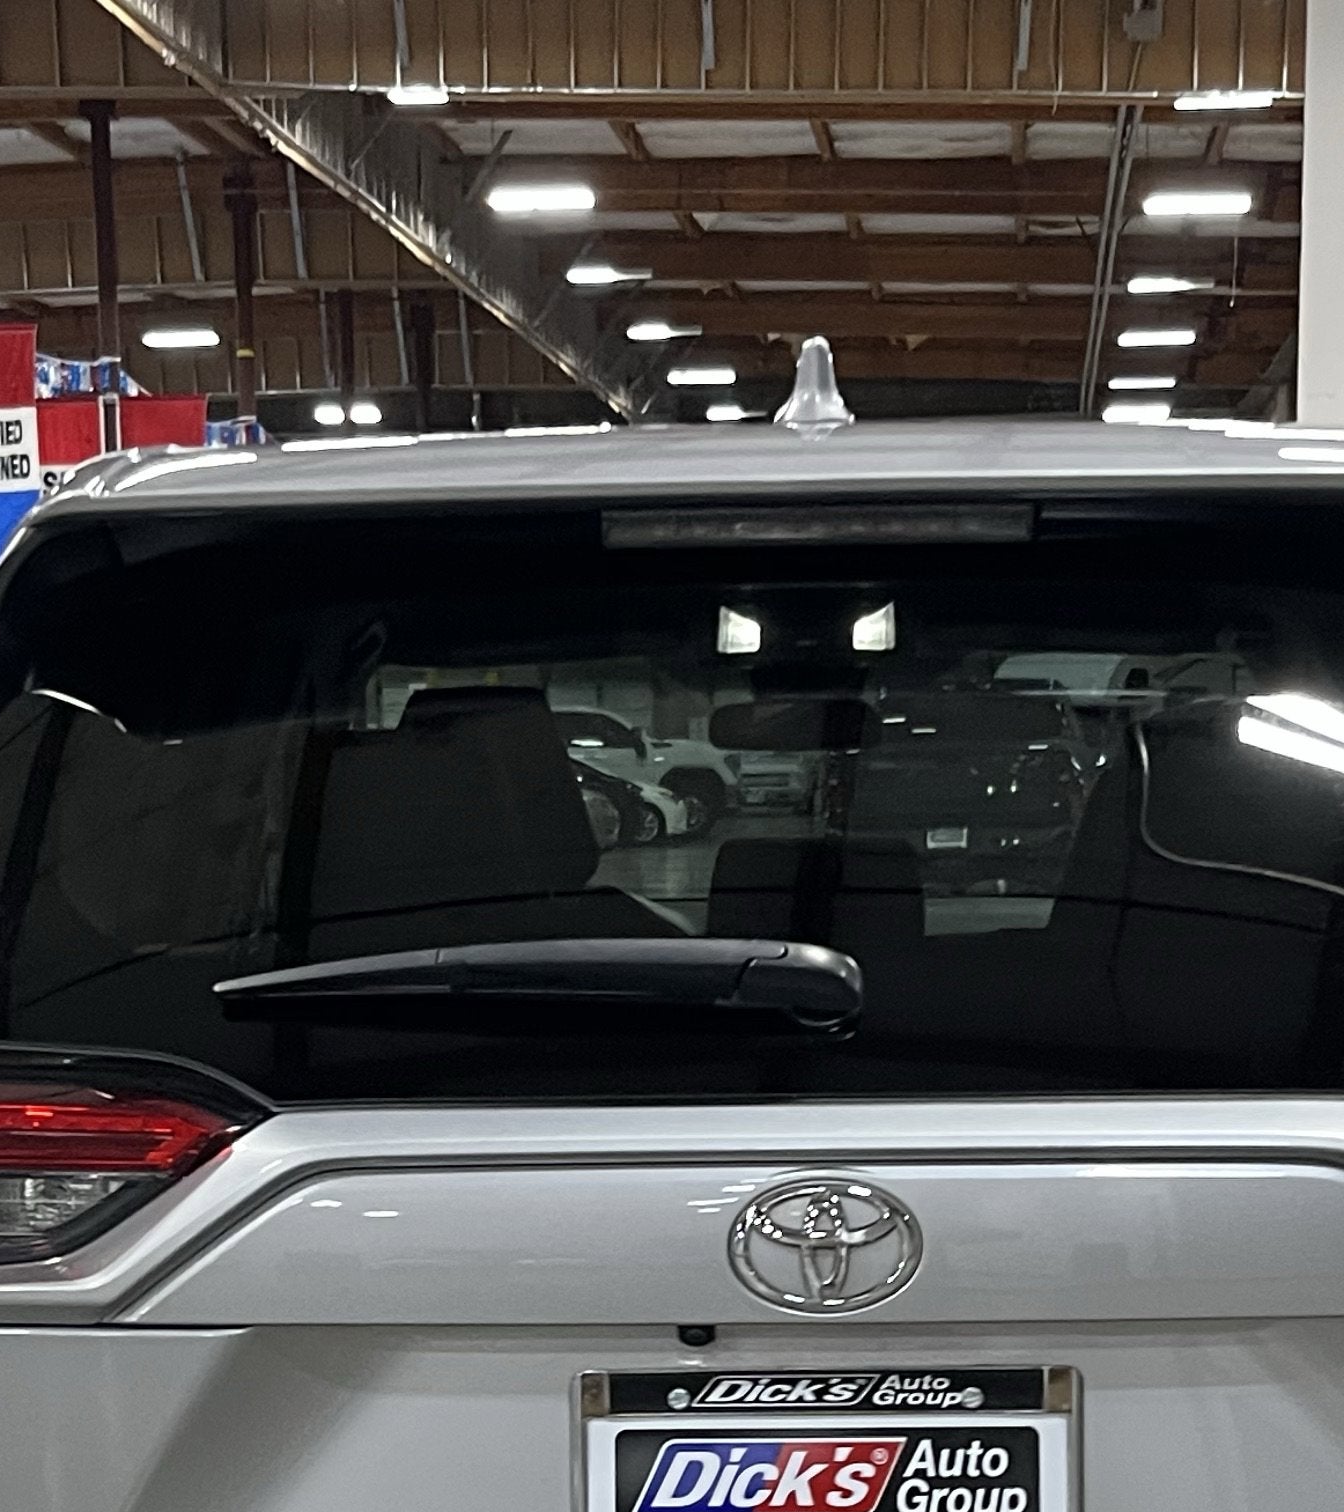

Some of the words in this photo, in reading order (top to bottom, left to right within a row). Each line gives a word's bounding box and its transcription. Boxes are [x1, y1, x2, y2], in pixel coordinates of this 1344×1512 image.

[705, 1378, 858, 1402] Dick's
[880, 1375, 951, 1391] Auto
[872, 1390, 962, 1408] Group
[902, 1439, 1010, 1478] Auto
[650, 1446, 877, 1508] Dick's
